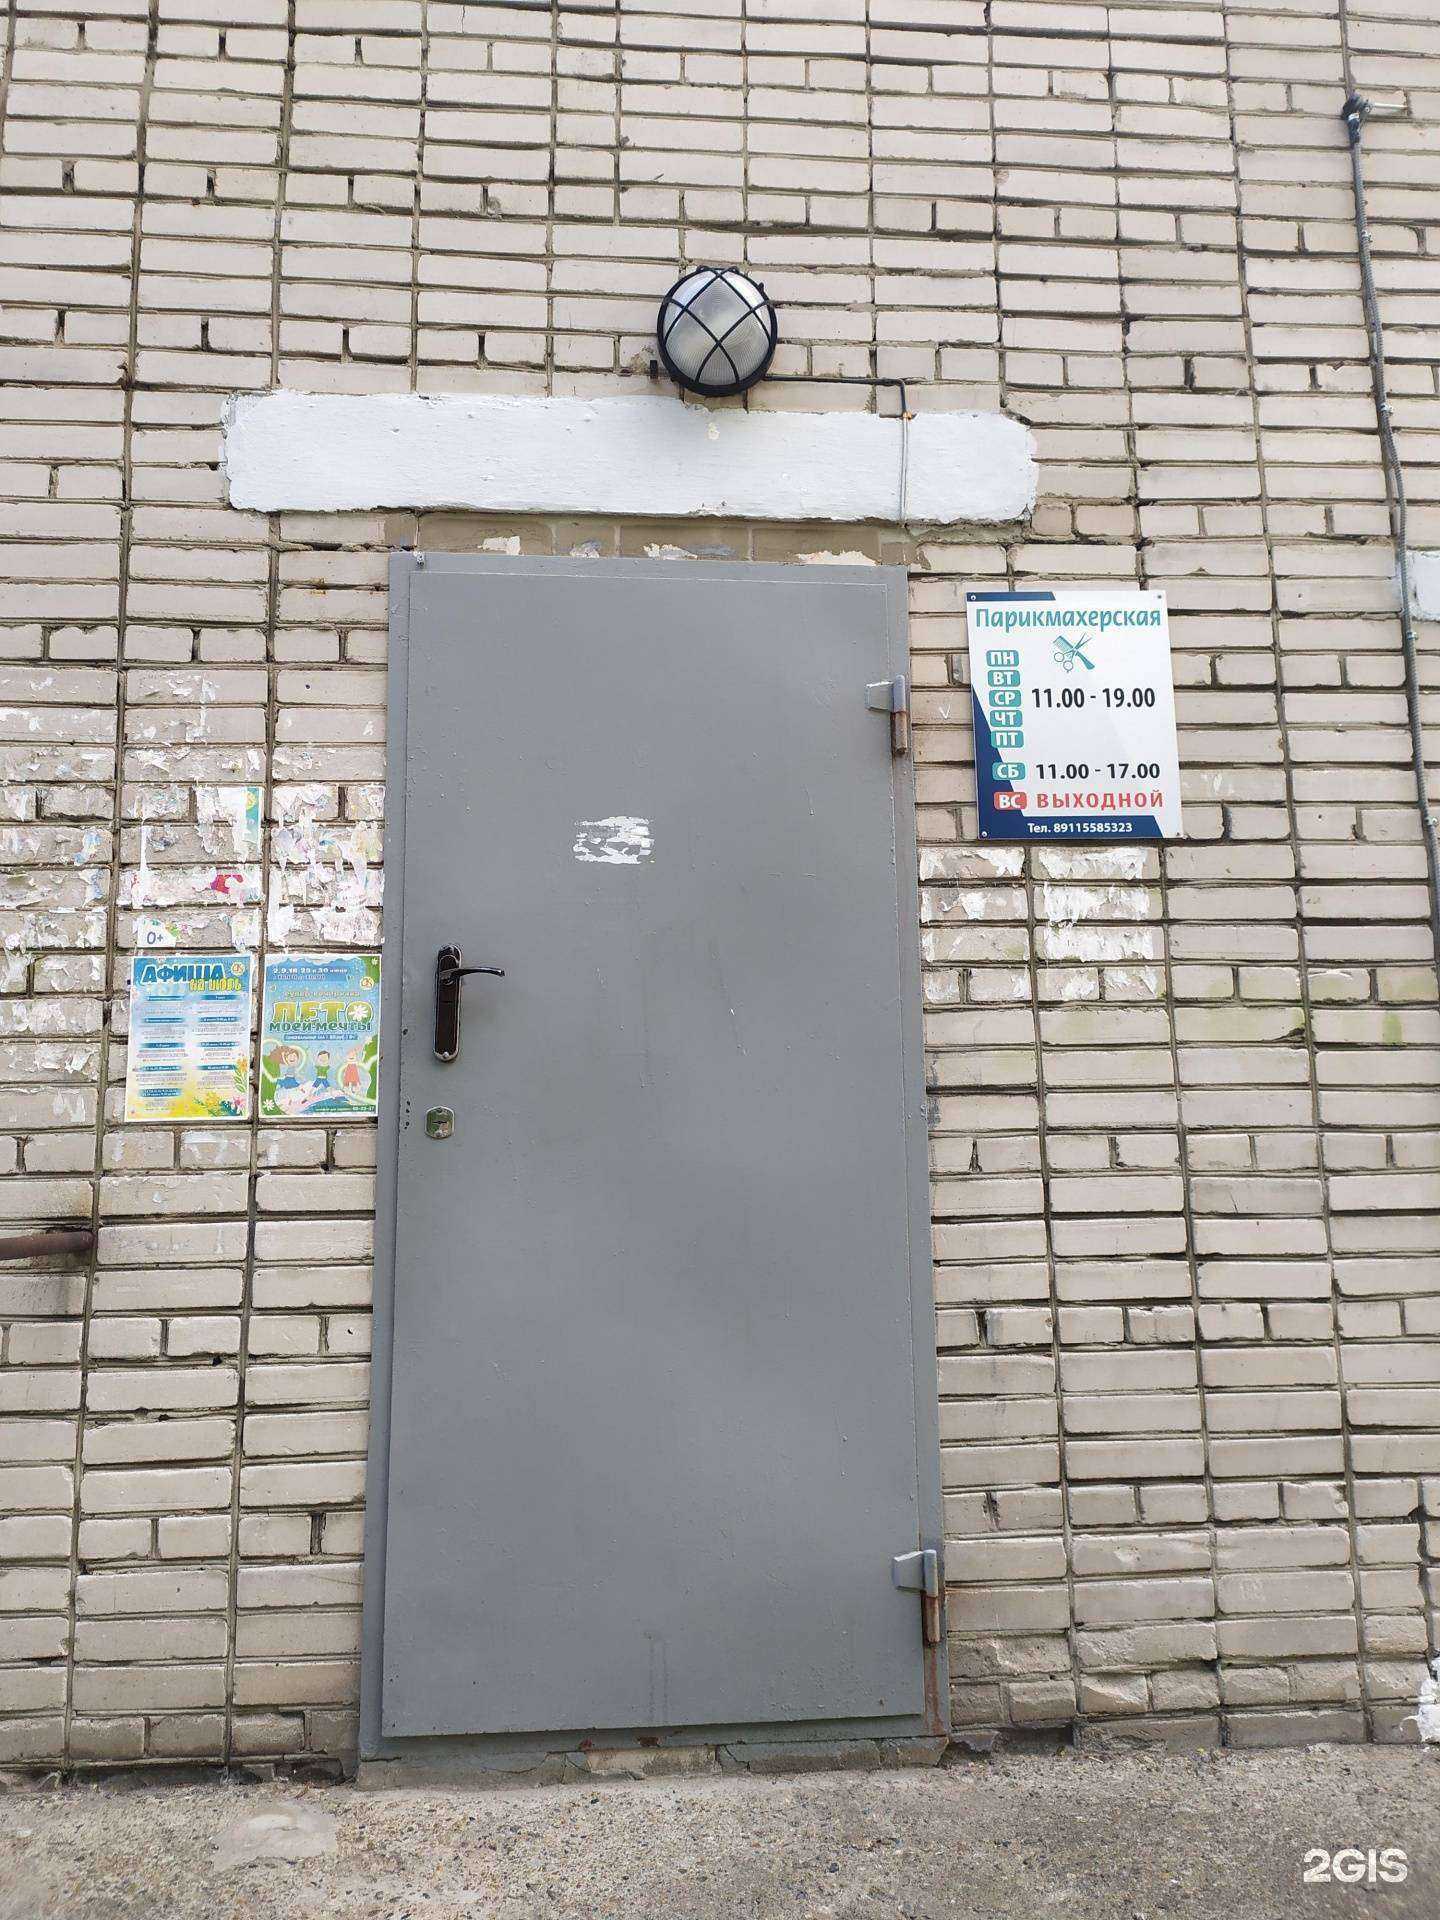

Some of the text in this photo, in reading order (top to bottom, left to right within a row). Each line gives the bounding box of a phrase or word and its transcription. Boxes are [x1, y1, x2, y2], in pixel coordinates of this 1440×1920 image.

[975, 608, 1161, 632] Парикмахерская
[990, 652, 1015, 665] ПН
[992, 672, 1014, 684] ВТ
[994, 692, 1015, 704] СР
[1031, 688, 1085, 708] 11.00
[1102, 688, 1155, 708] 19.00
[995, 712, 1016, 724] ЧТ
[995, 733, 1018, 746] ПТ
[996, 765, 1019, 778] СБ
[1036, 763, 1089, 779] 11.00
[1107, 763, 1160, 779] 17.00
[998, 789, 1164, 810] ВС ВЫХОДНОЙ
[1027, 822, 1132, 833] Тел. 89115585323
[142, 965, 225, 983] АФИША
[273, 1001, 374, 1024] ЛЕТО
